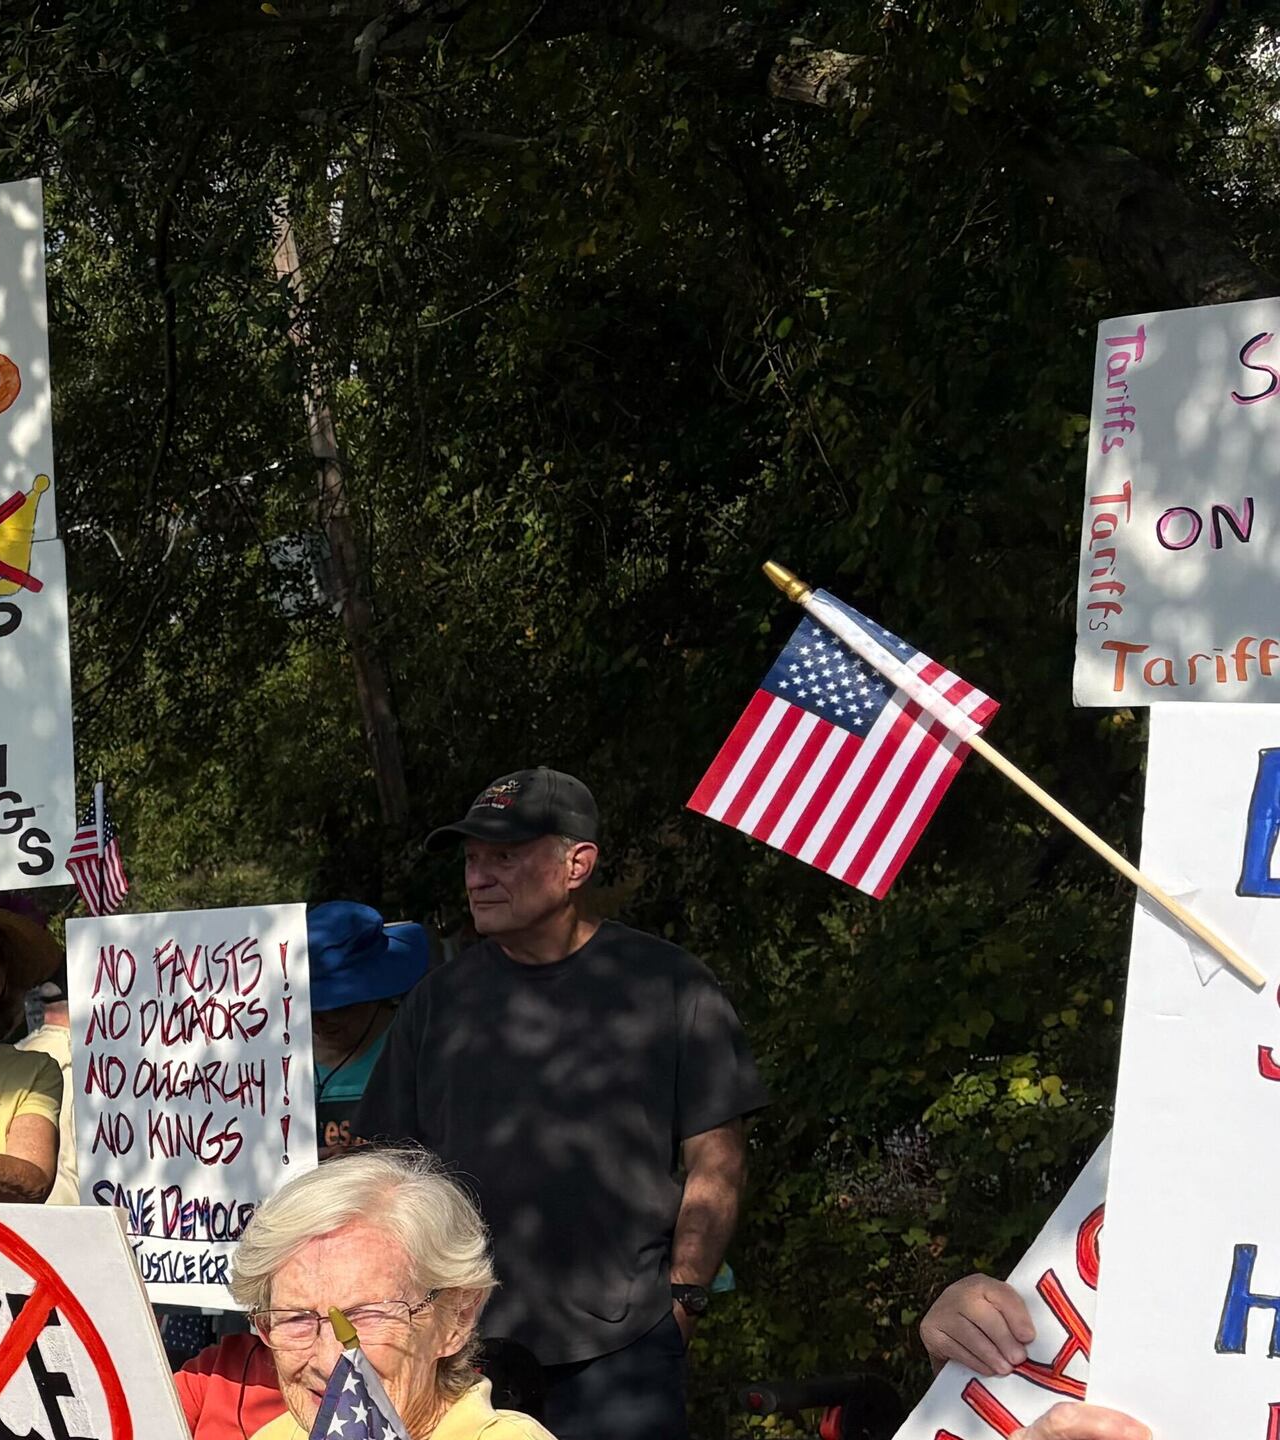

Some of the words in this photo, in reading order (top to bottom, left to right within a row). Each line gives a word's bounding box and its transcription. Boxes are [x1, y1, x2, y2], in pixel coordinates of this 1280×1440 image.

[1101, 323, 1148, 455] Tariffs
[1155, 497, 1255, 551] ON
[1087, 480, 1132, 632] Tariffs
[91, 944, 137, 999] NO
[85, 1000, 132, 1046] NO
[85, 1051, 127, 1100] NO
[133, 1056, 267, 1117] OLIGARCHY
[92, 1111, 135, 1158] NO
[147, 1108, 244, 1166] KINGS
[199, 1248, 230, 1285] FOR
